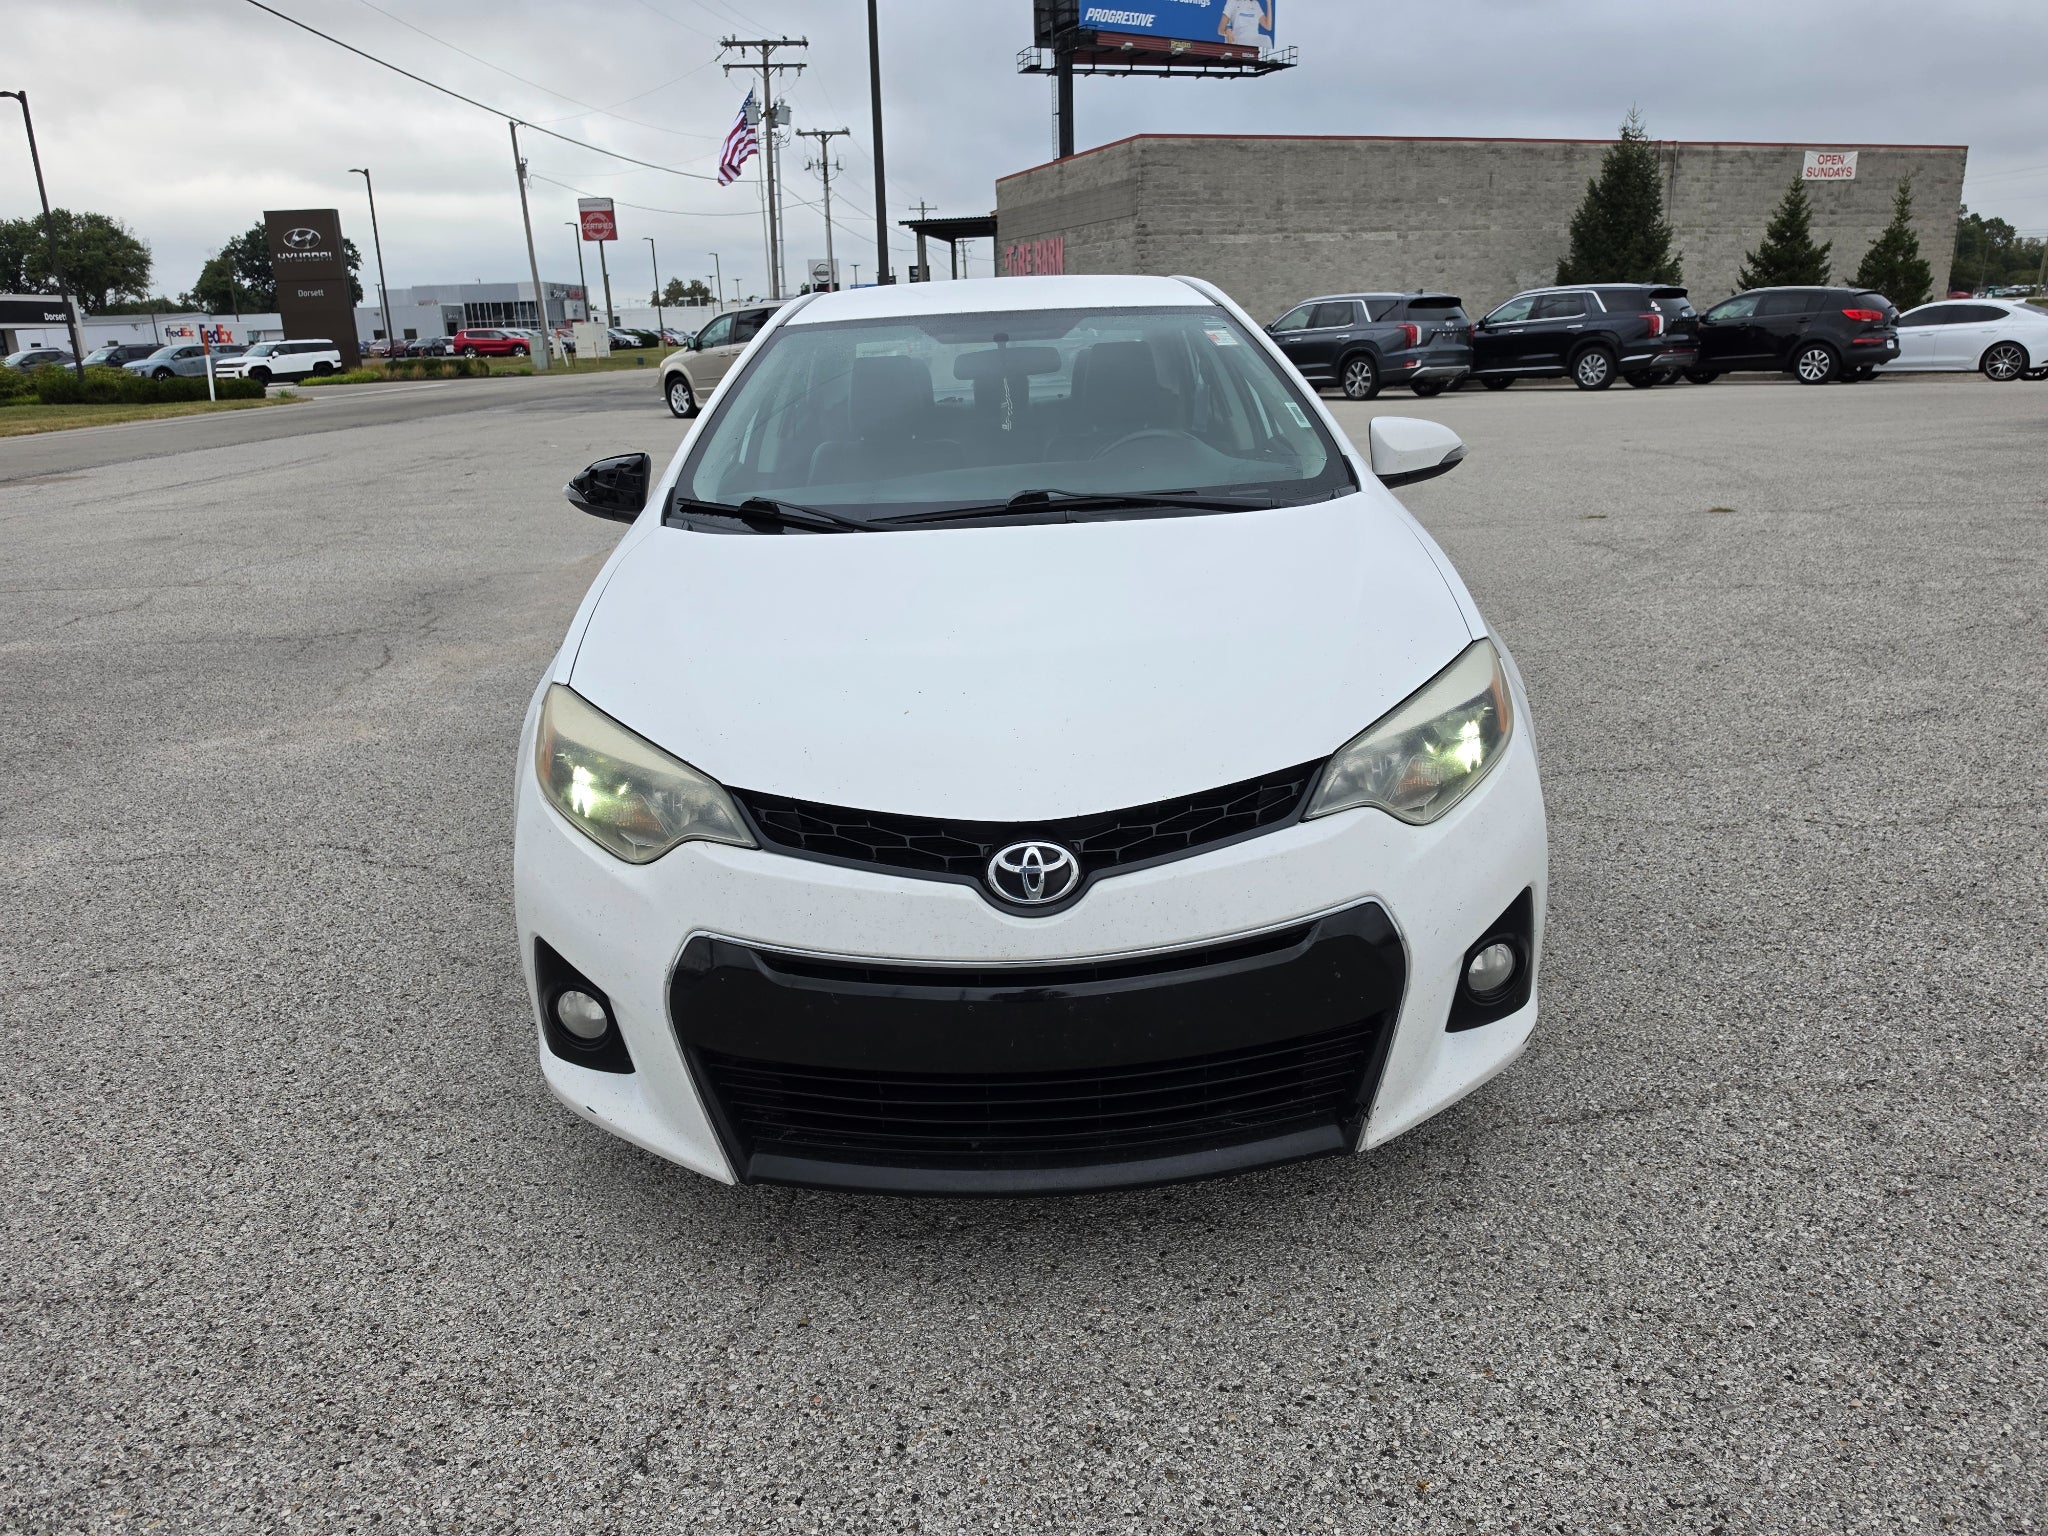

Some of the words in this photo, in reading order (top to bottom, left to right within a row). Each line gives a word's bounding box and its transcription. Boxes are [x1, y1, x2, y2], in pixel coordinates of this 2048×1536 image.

[1085, 8, 1156, 27] PROGRESSIVE
[1817, 154, 1845, 165] OPEN
[1806, 166, 1852, 177] SUNDAYS
[582, 222, 614, 230] CERTIFIED
[1035, 235, 1064, 276] BARN
[297, 289, 324, 297] Dorsett
[164, 326, 195, 337] FedEx
[198, 323, 235, 345] FedEx
